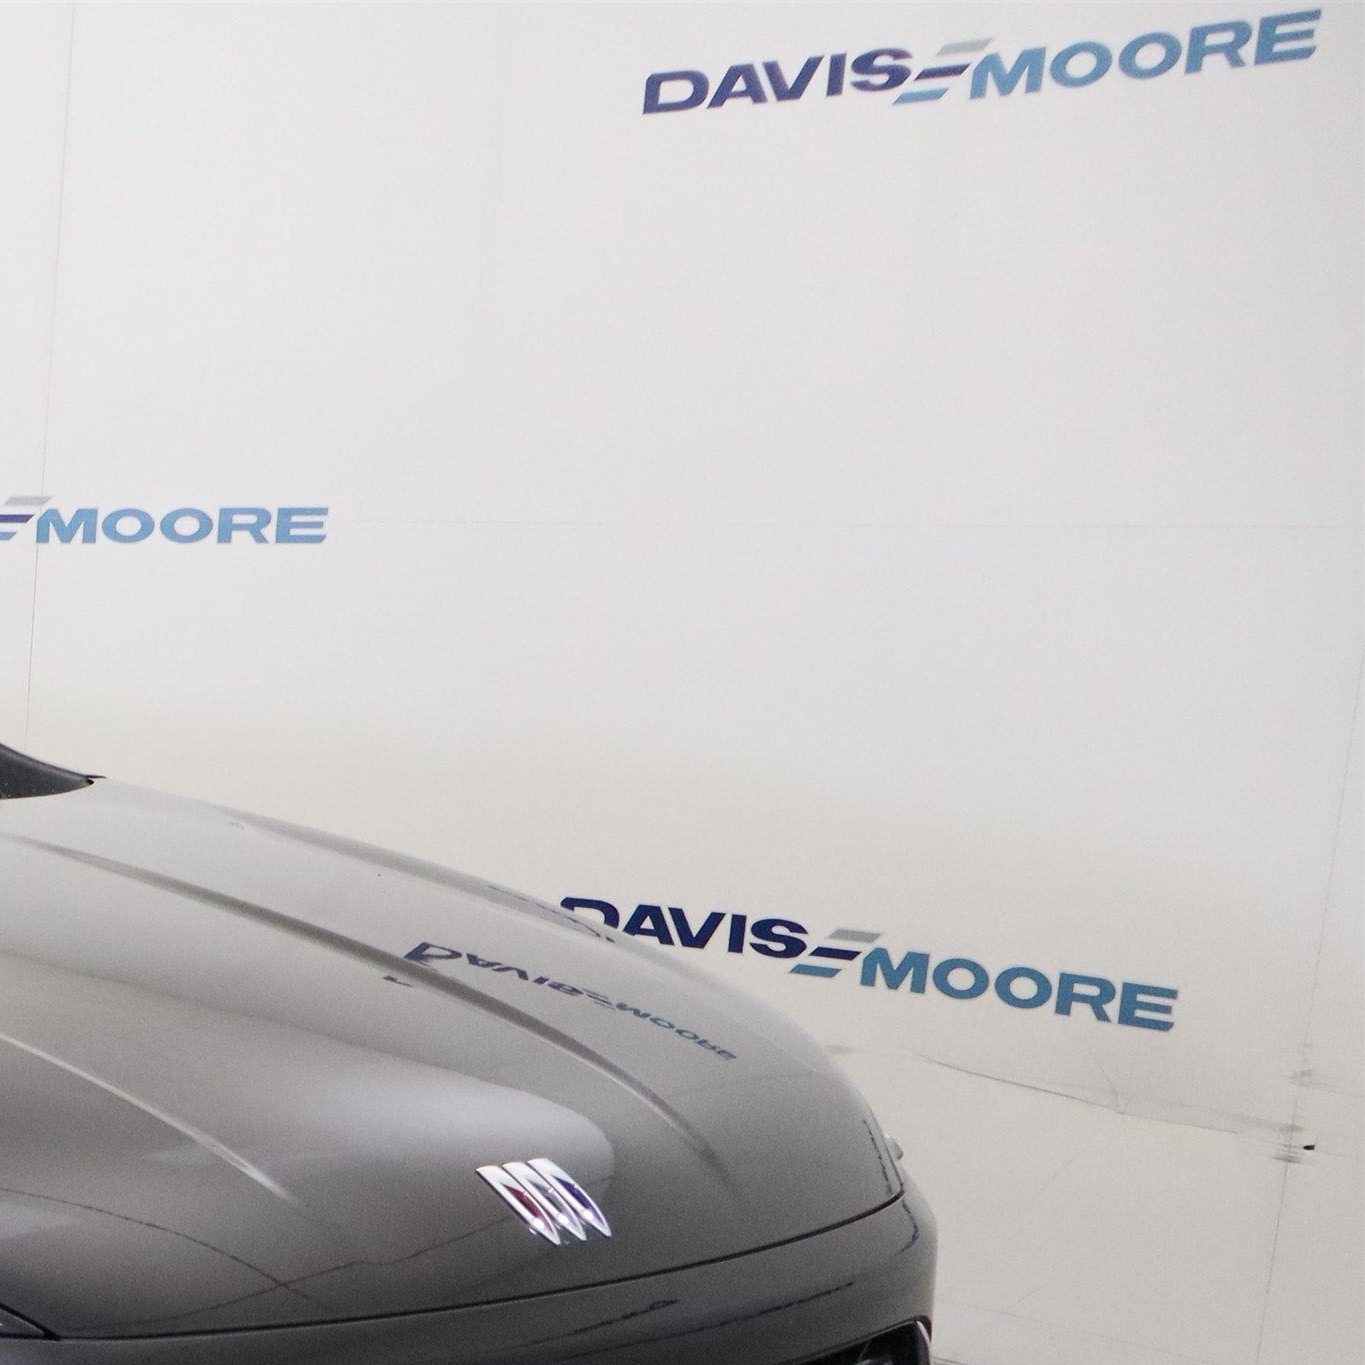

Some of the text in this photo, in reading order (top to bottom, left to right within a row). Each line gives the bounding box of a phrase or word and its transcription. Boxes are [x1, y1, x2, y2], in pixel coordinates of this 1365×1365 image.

[643, 9, 1320, 114] DAVIS MOORE
[35, 507, 328, 544] MOORE
[860, 947, 1178, 1031] MOORE
